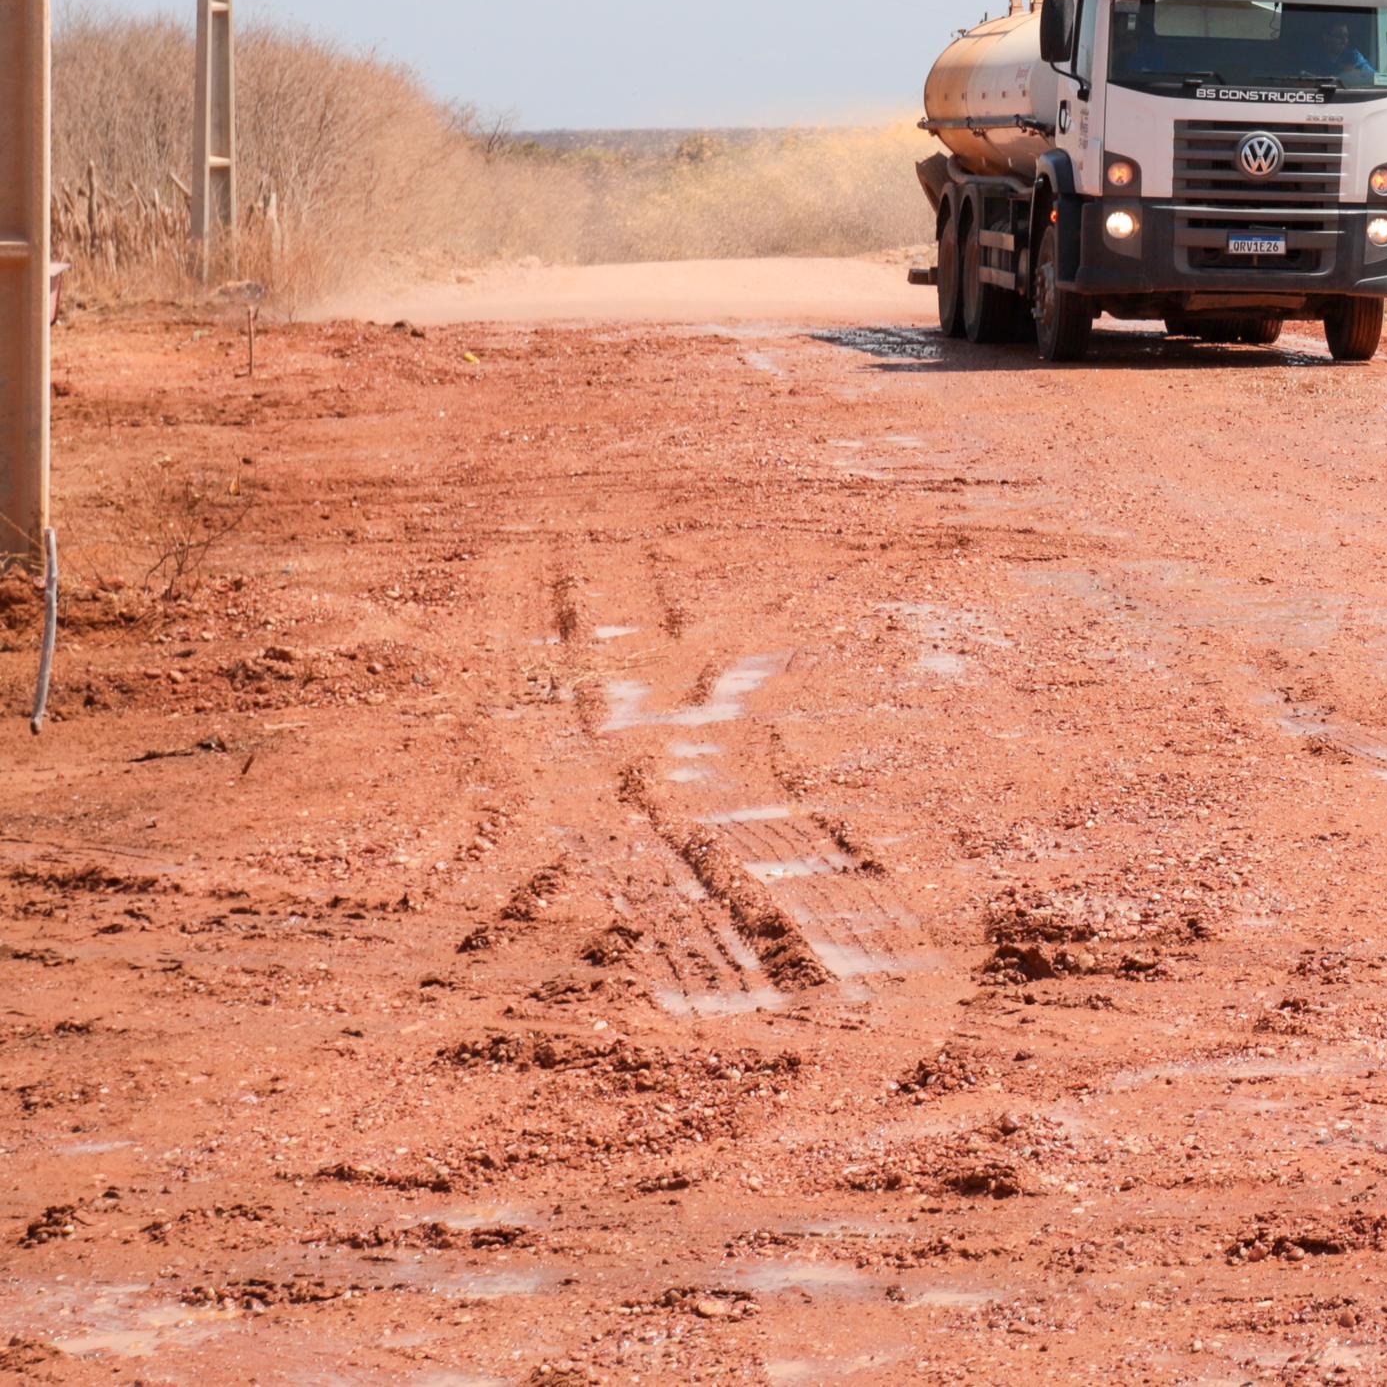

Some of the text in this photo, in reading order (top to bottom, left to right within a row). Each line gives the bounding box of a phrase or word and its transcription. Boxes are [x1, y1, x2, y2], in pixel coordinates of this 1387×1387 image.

[1196, 88, 1324, 103] BS CONSTRUÇÕES
[1233, 241, 1279, 253] QRV1E26
